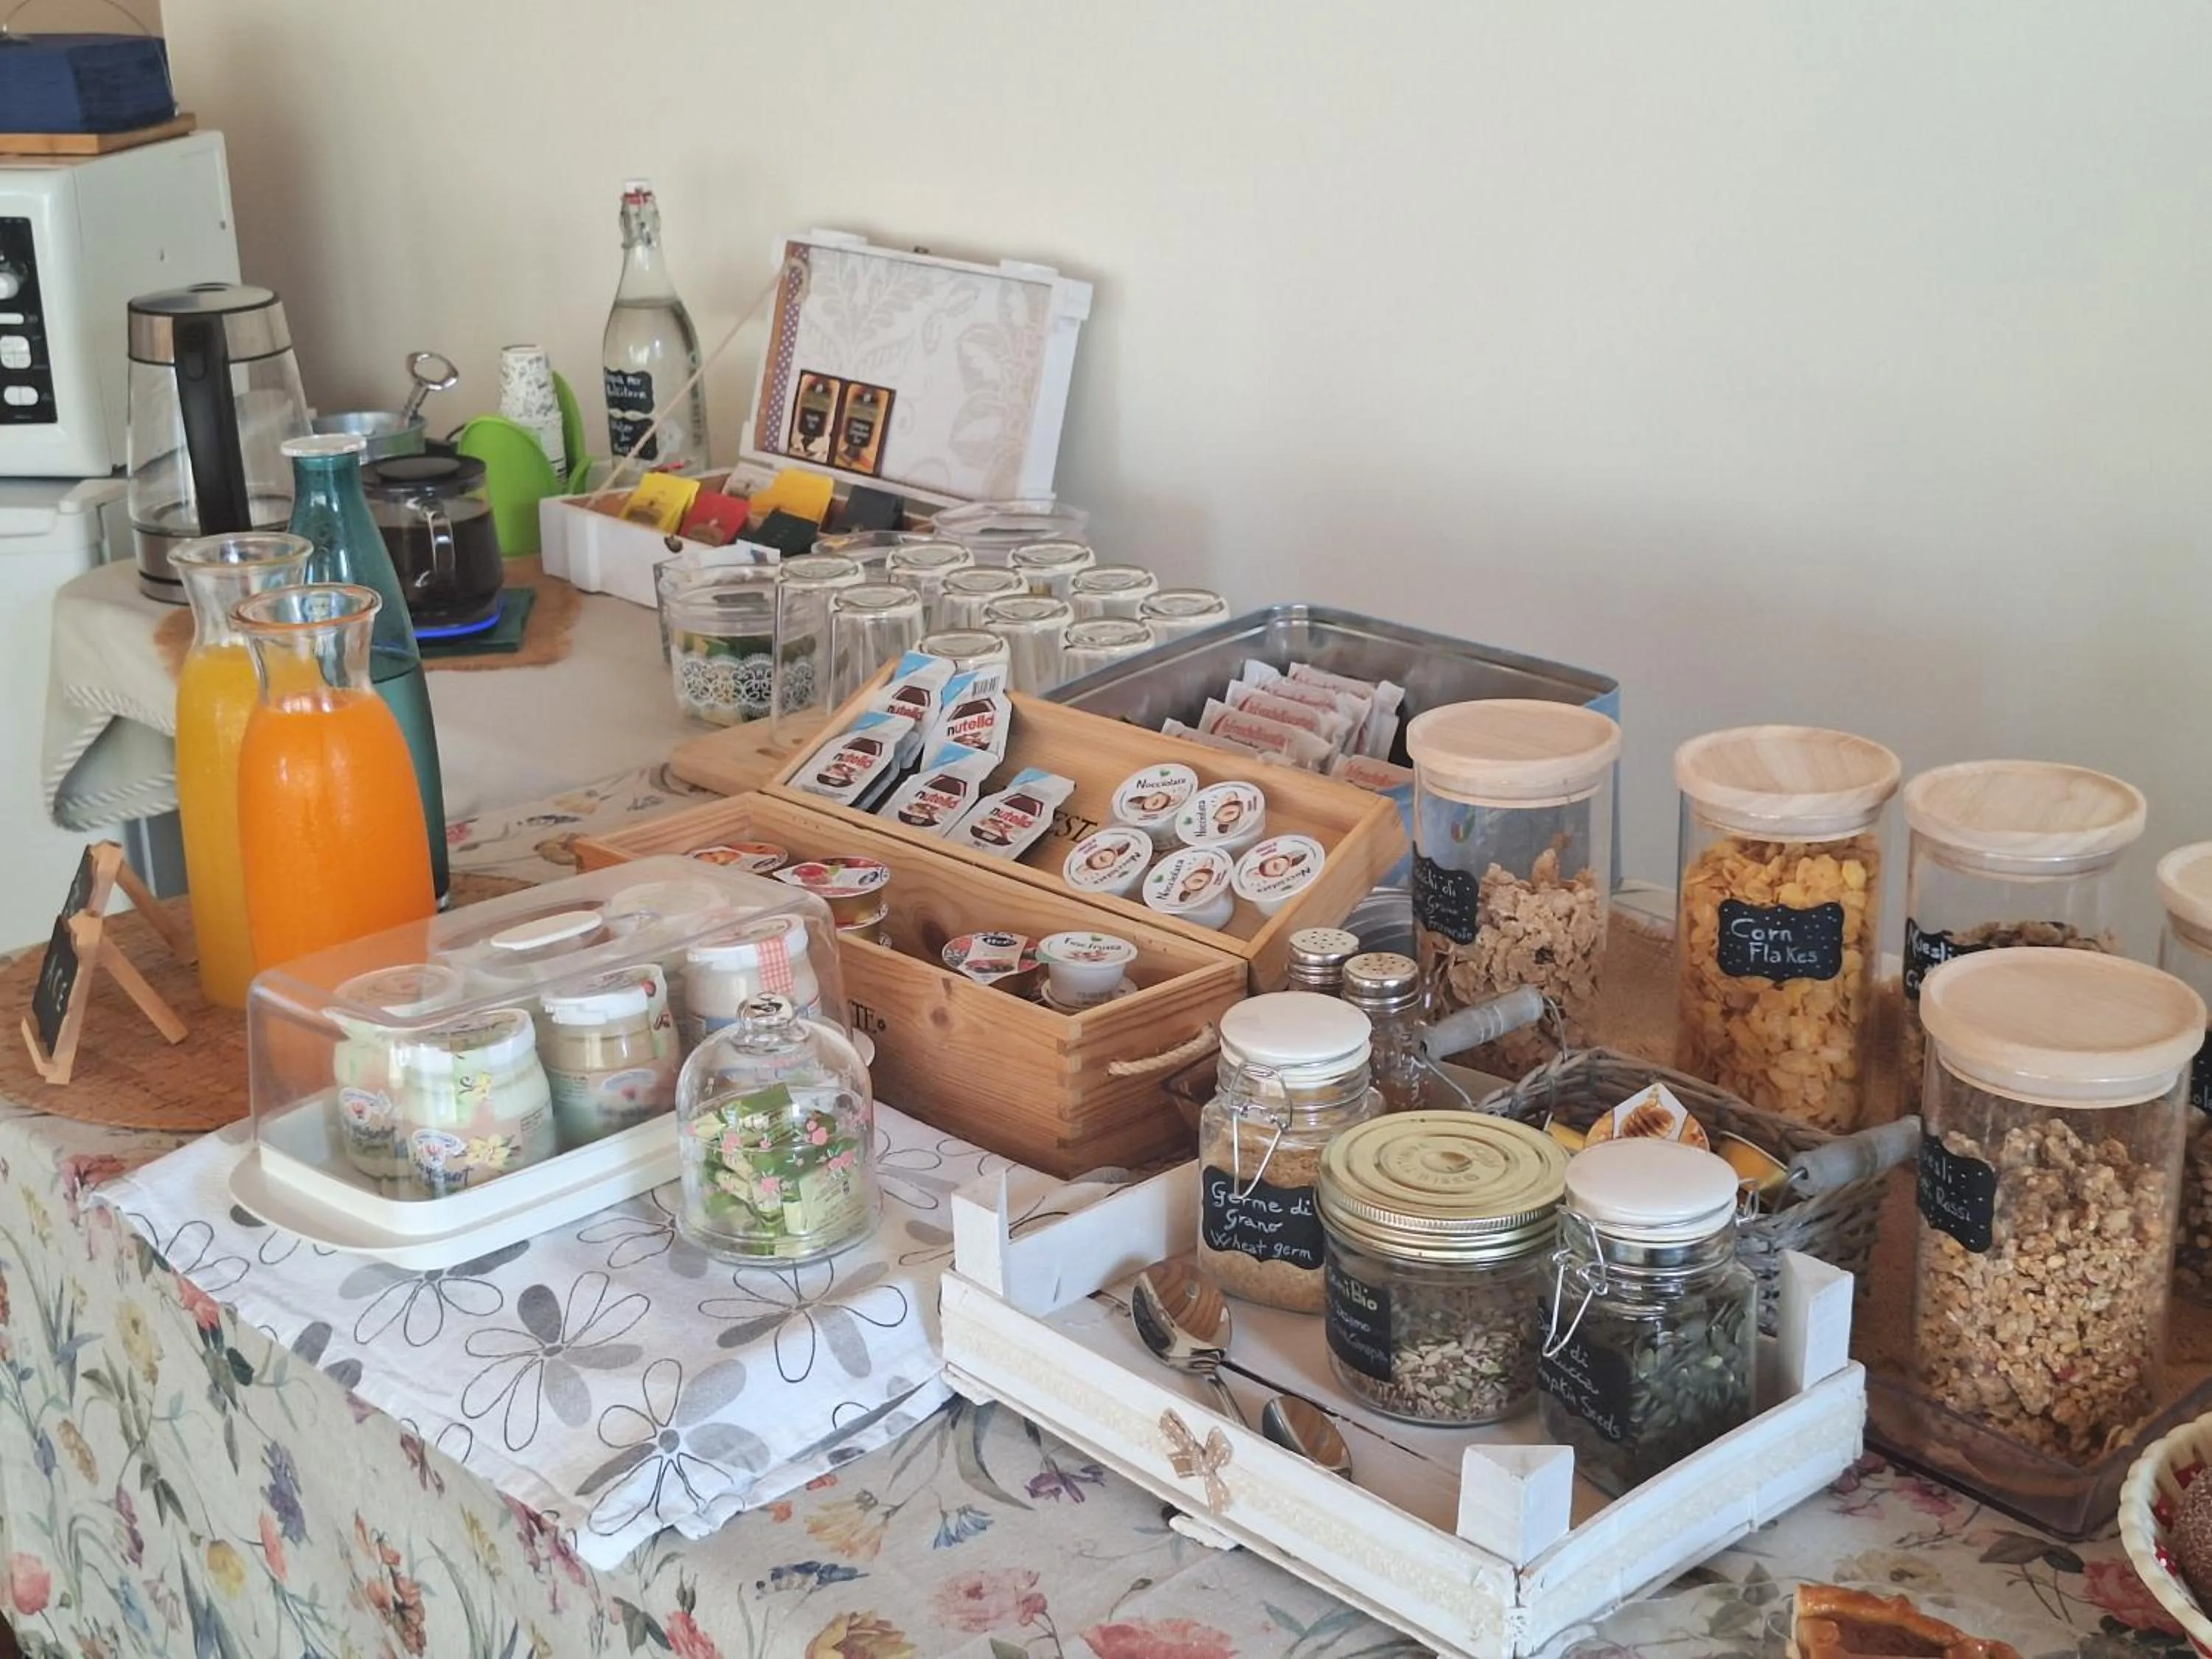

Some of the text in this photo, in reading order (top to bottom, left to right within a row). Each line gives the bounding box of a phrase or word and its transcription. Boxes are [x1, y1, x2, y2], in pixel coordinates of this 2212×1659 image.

[947, 714, 995, 736] nutella
[833, 752, 874, 770] nutella
[914, 790, 960, 810] nutella
[990, 807, 1034, 828] nutella
[1731, 917, 1793, 942] Corn
[1211, 1180, 1313, 1216] Germe di
[1223, 1208, 1284, 1234] Grano
[1209, 1228, 1312, 1262] Wheat germ
[1570, 1343, 1589, 1368] di
